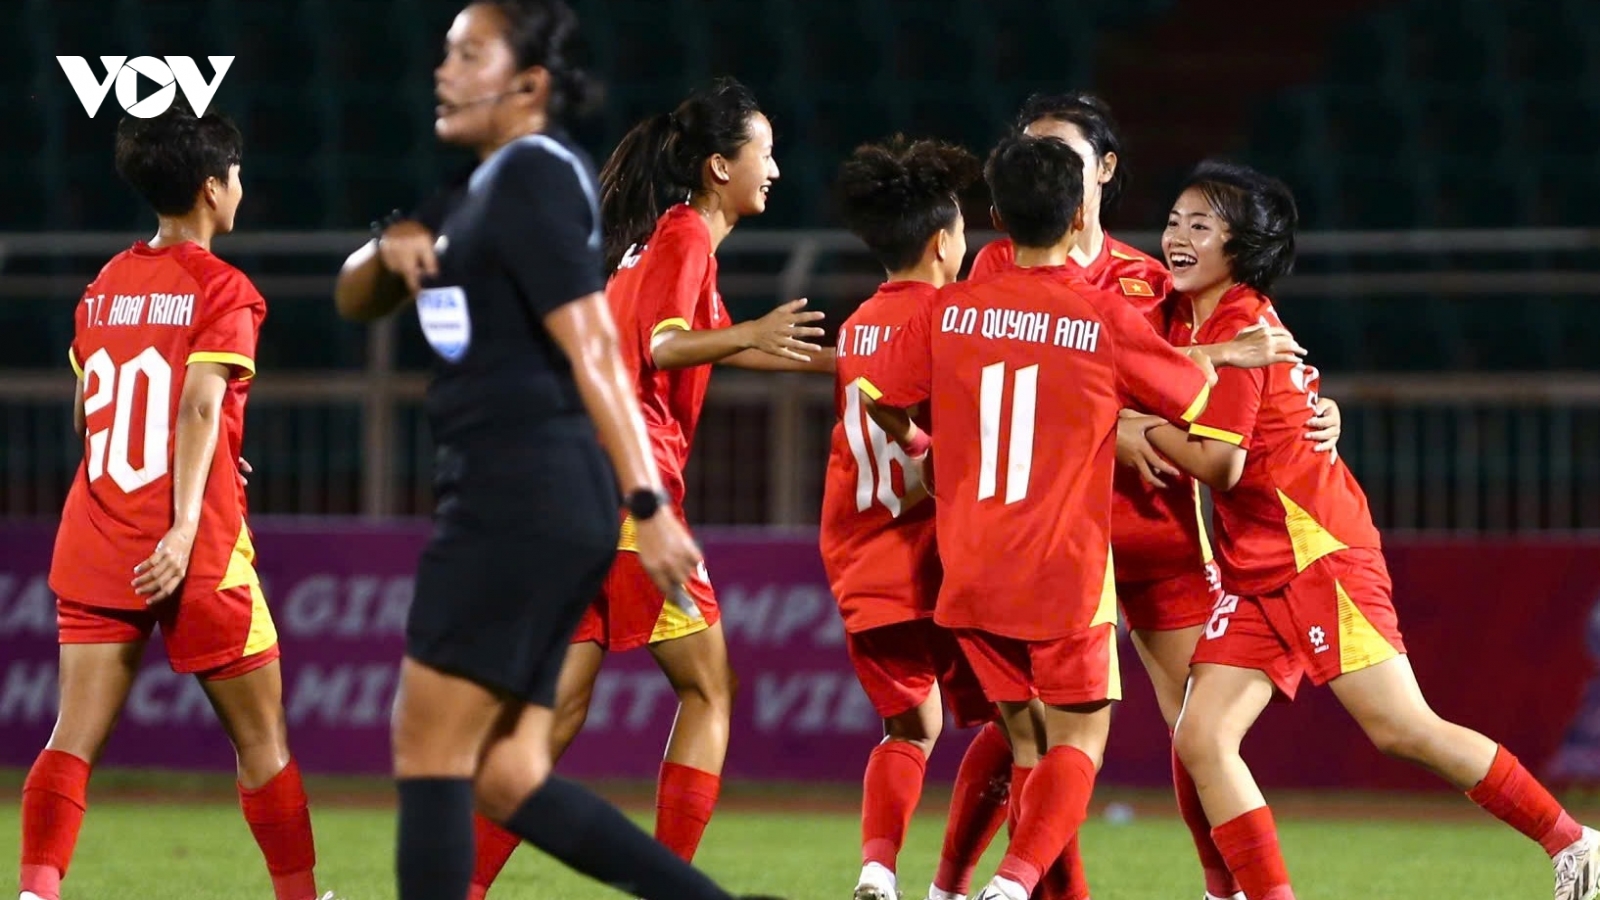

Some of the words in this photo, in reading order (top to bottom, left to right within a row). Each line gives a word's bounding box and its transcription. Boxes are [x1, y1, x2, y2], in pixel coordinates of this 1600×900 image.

[107, 294, 146, 326] HOAI
[146, 292, 195, 326] TRINH
[980, 308, 1050, 343] QUYNH
[1053, 317, 1100, 353] ANH
[83, 346, 172, 494] 20
[977, 361, 1040, 505] 11
